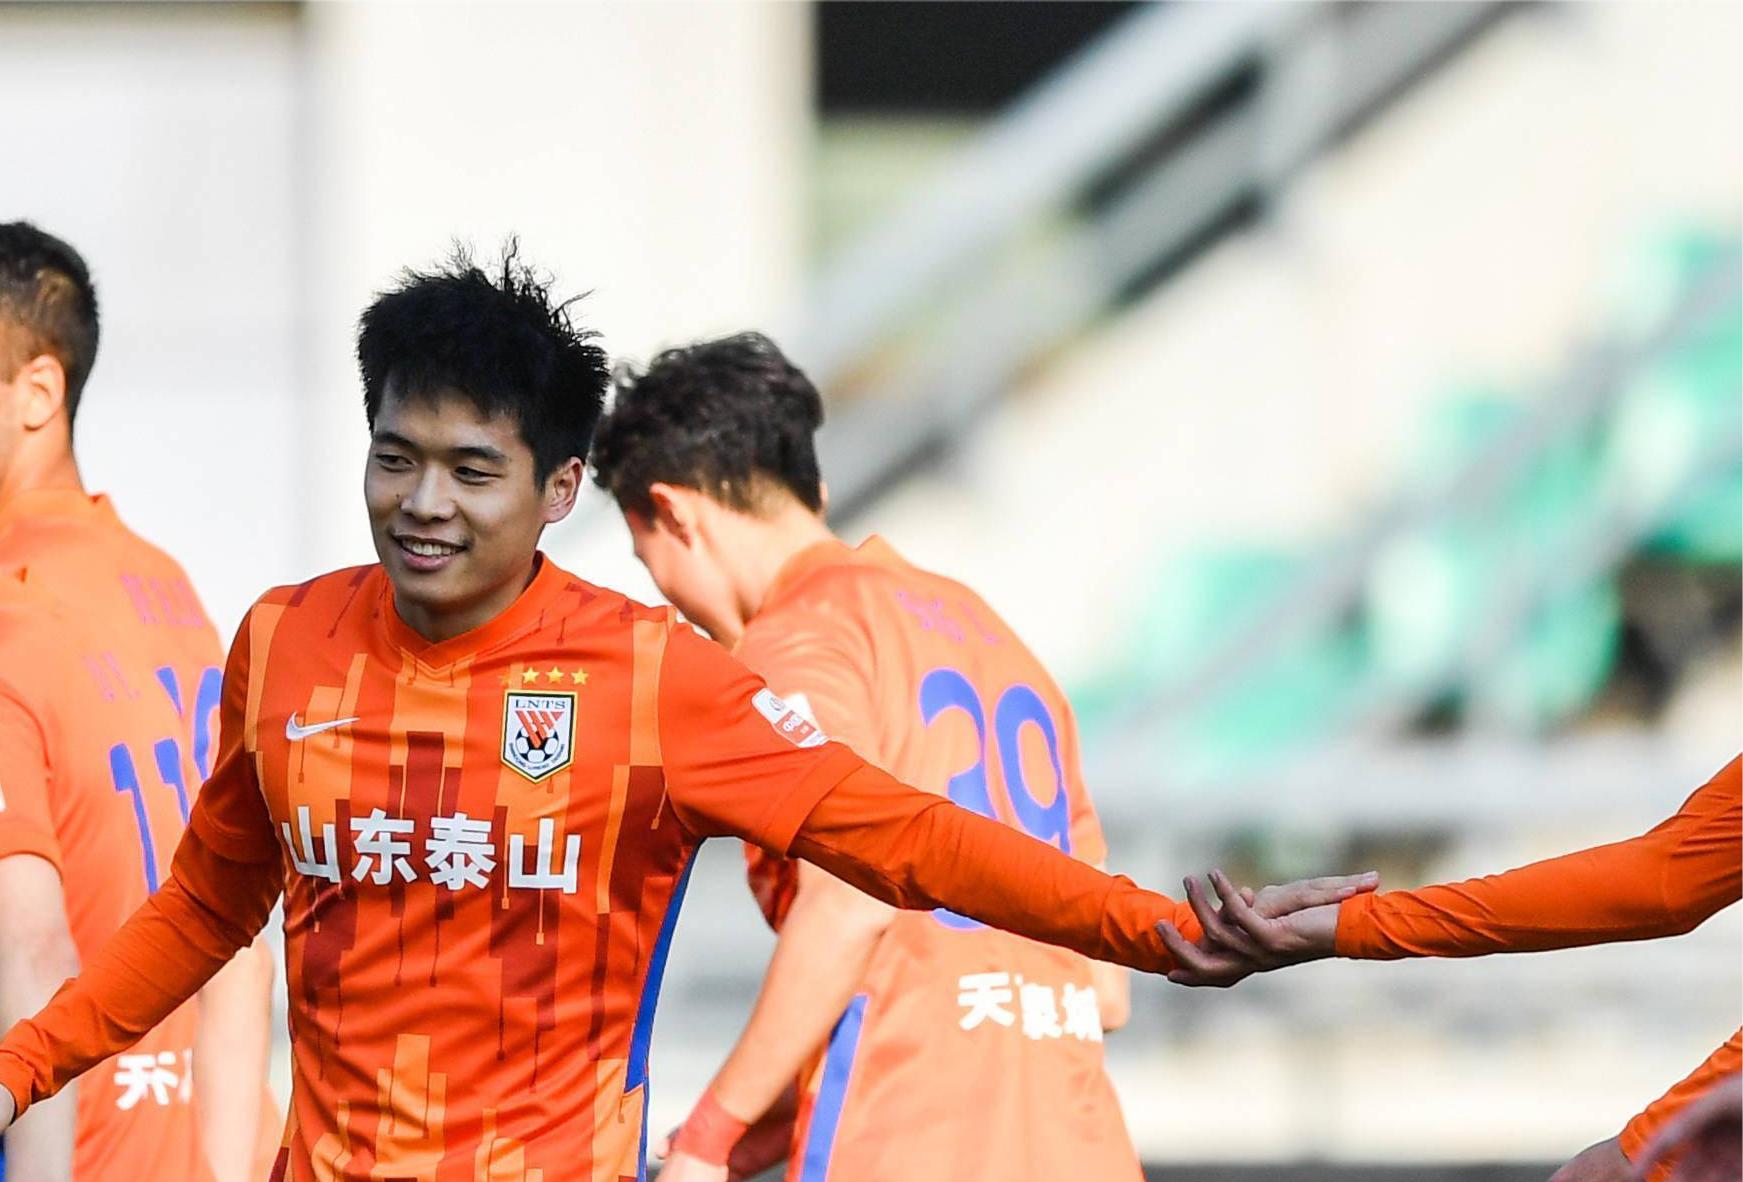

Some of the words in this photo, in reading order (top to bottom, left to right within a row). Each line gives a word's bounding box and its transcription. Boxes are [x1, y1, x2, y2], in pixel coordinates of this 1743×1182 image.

[515, 699, 566, 709] LNTS
[281, 806, 582, 895] 山东泰山
